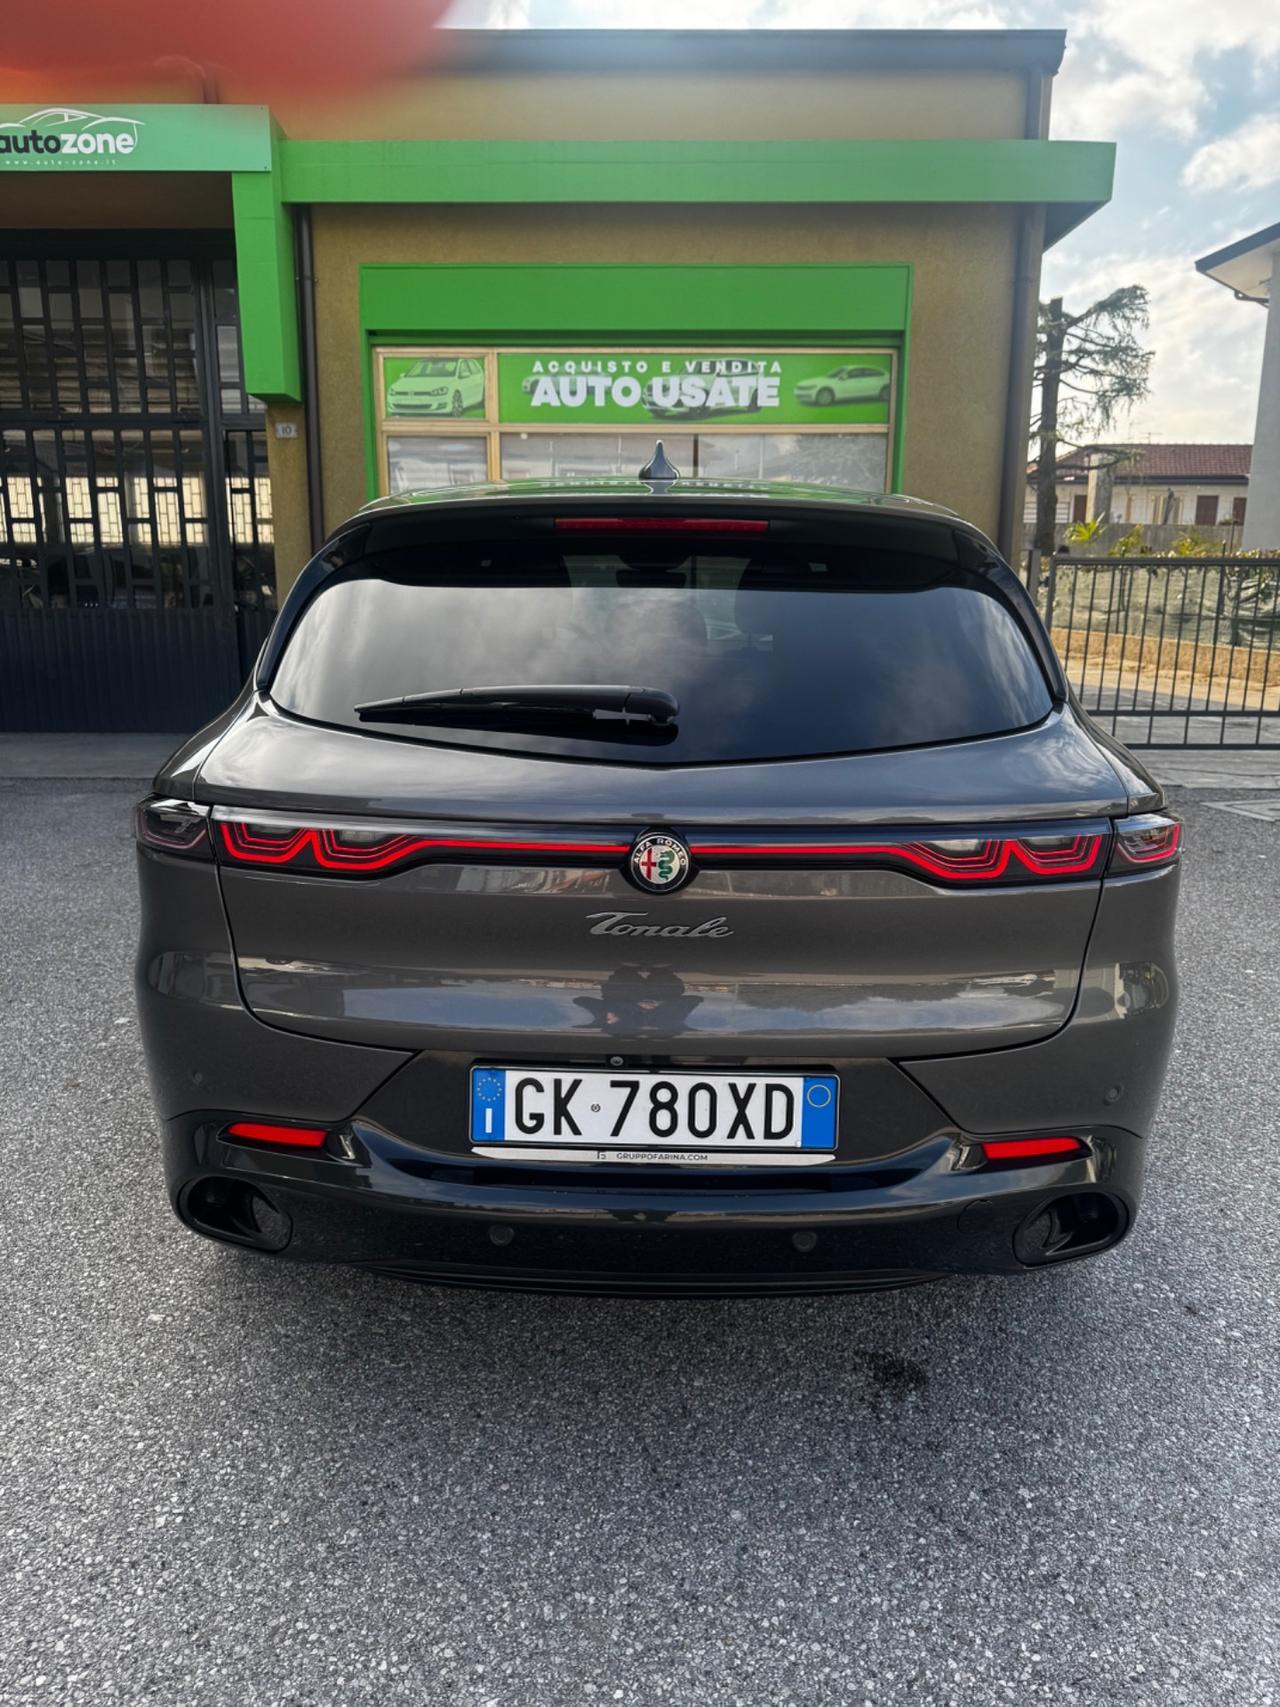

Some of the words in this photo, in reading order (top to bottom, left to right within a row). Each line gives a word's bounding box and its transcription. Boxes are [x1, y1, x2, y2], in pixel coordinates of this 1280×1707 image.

[0, 129, 134, 154] autozone
[532, 360, 648, 374] ACQUISTO
[662, 360, 671, 373] E
[685, 360, 782, 373] VENDITA
[530, 376, 642, 407] AUTO
[652, 376, 781, 407] USATE
[633, 841, 652, 864] ALFA
[656, 838, 686, 865] ROMEO
[585, 911, 735, 938] Tonale
[514, 1077, 583, 1136] GK
[609, 1080, 794, 1140] 780XD
[616, 1152, 708, 1161] GRUPPOFARINA.COM
